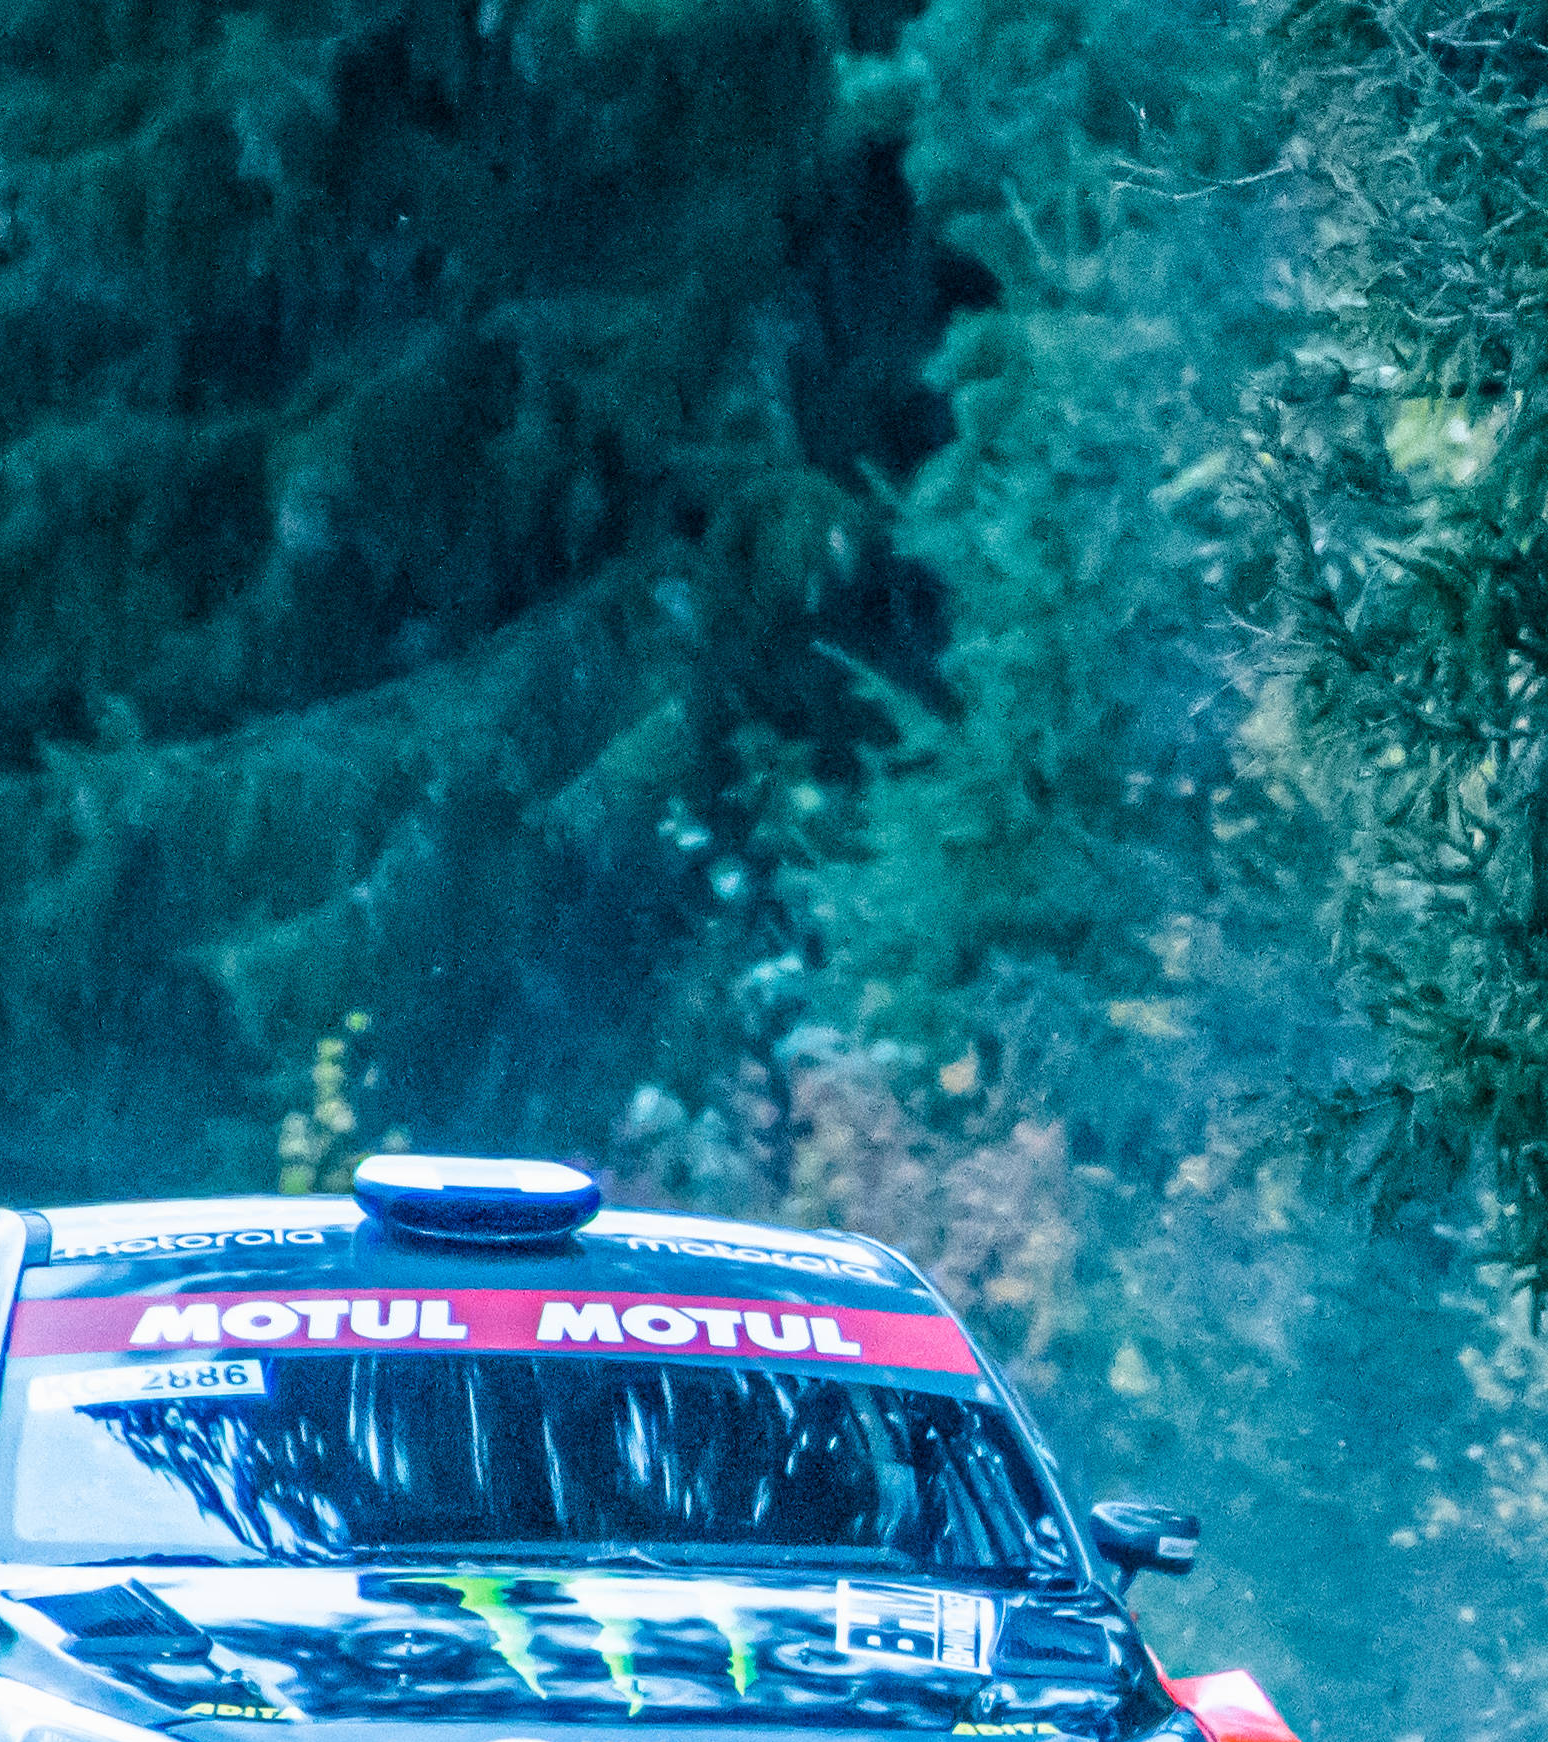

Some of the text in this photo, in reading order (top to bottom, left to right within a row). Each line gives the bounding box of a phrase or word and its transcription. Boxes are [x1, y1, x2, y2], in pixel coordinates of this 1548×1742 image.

[627, 1236, 878, 1279] motorola
[129, 1300, 861, 1356] MOTUL MOTUL
